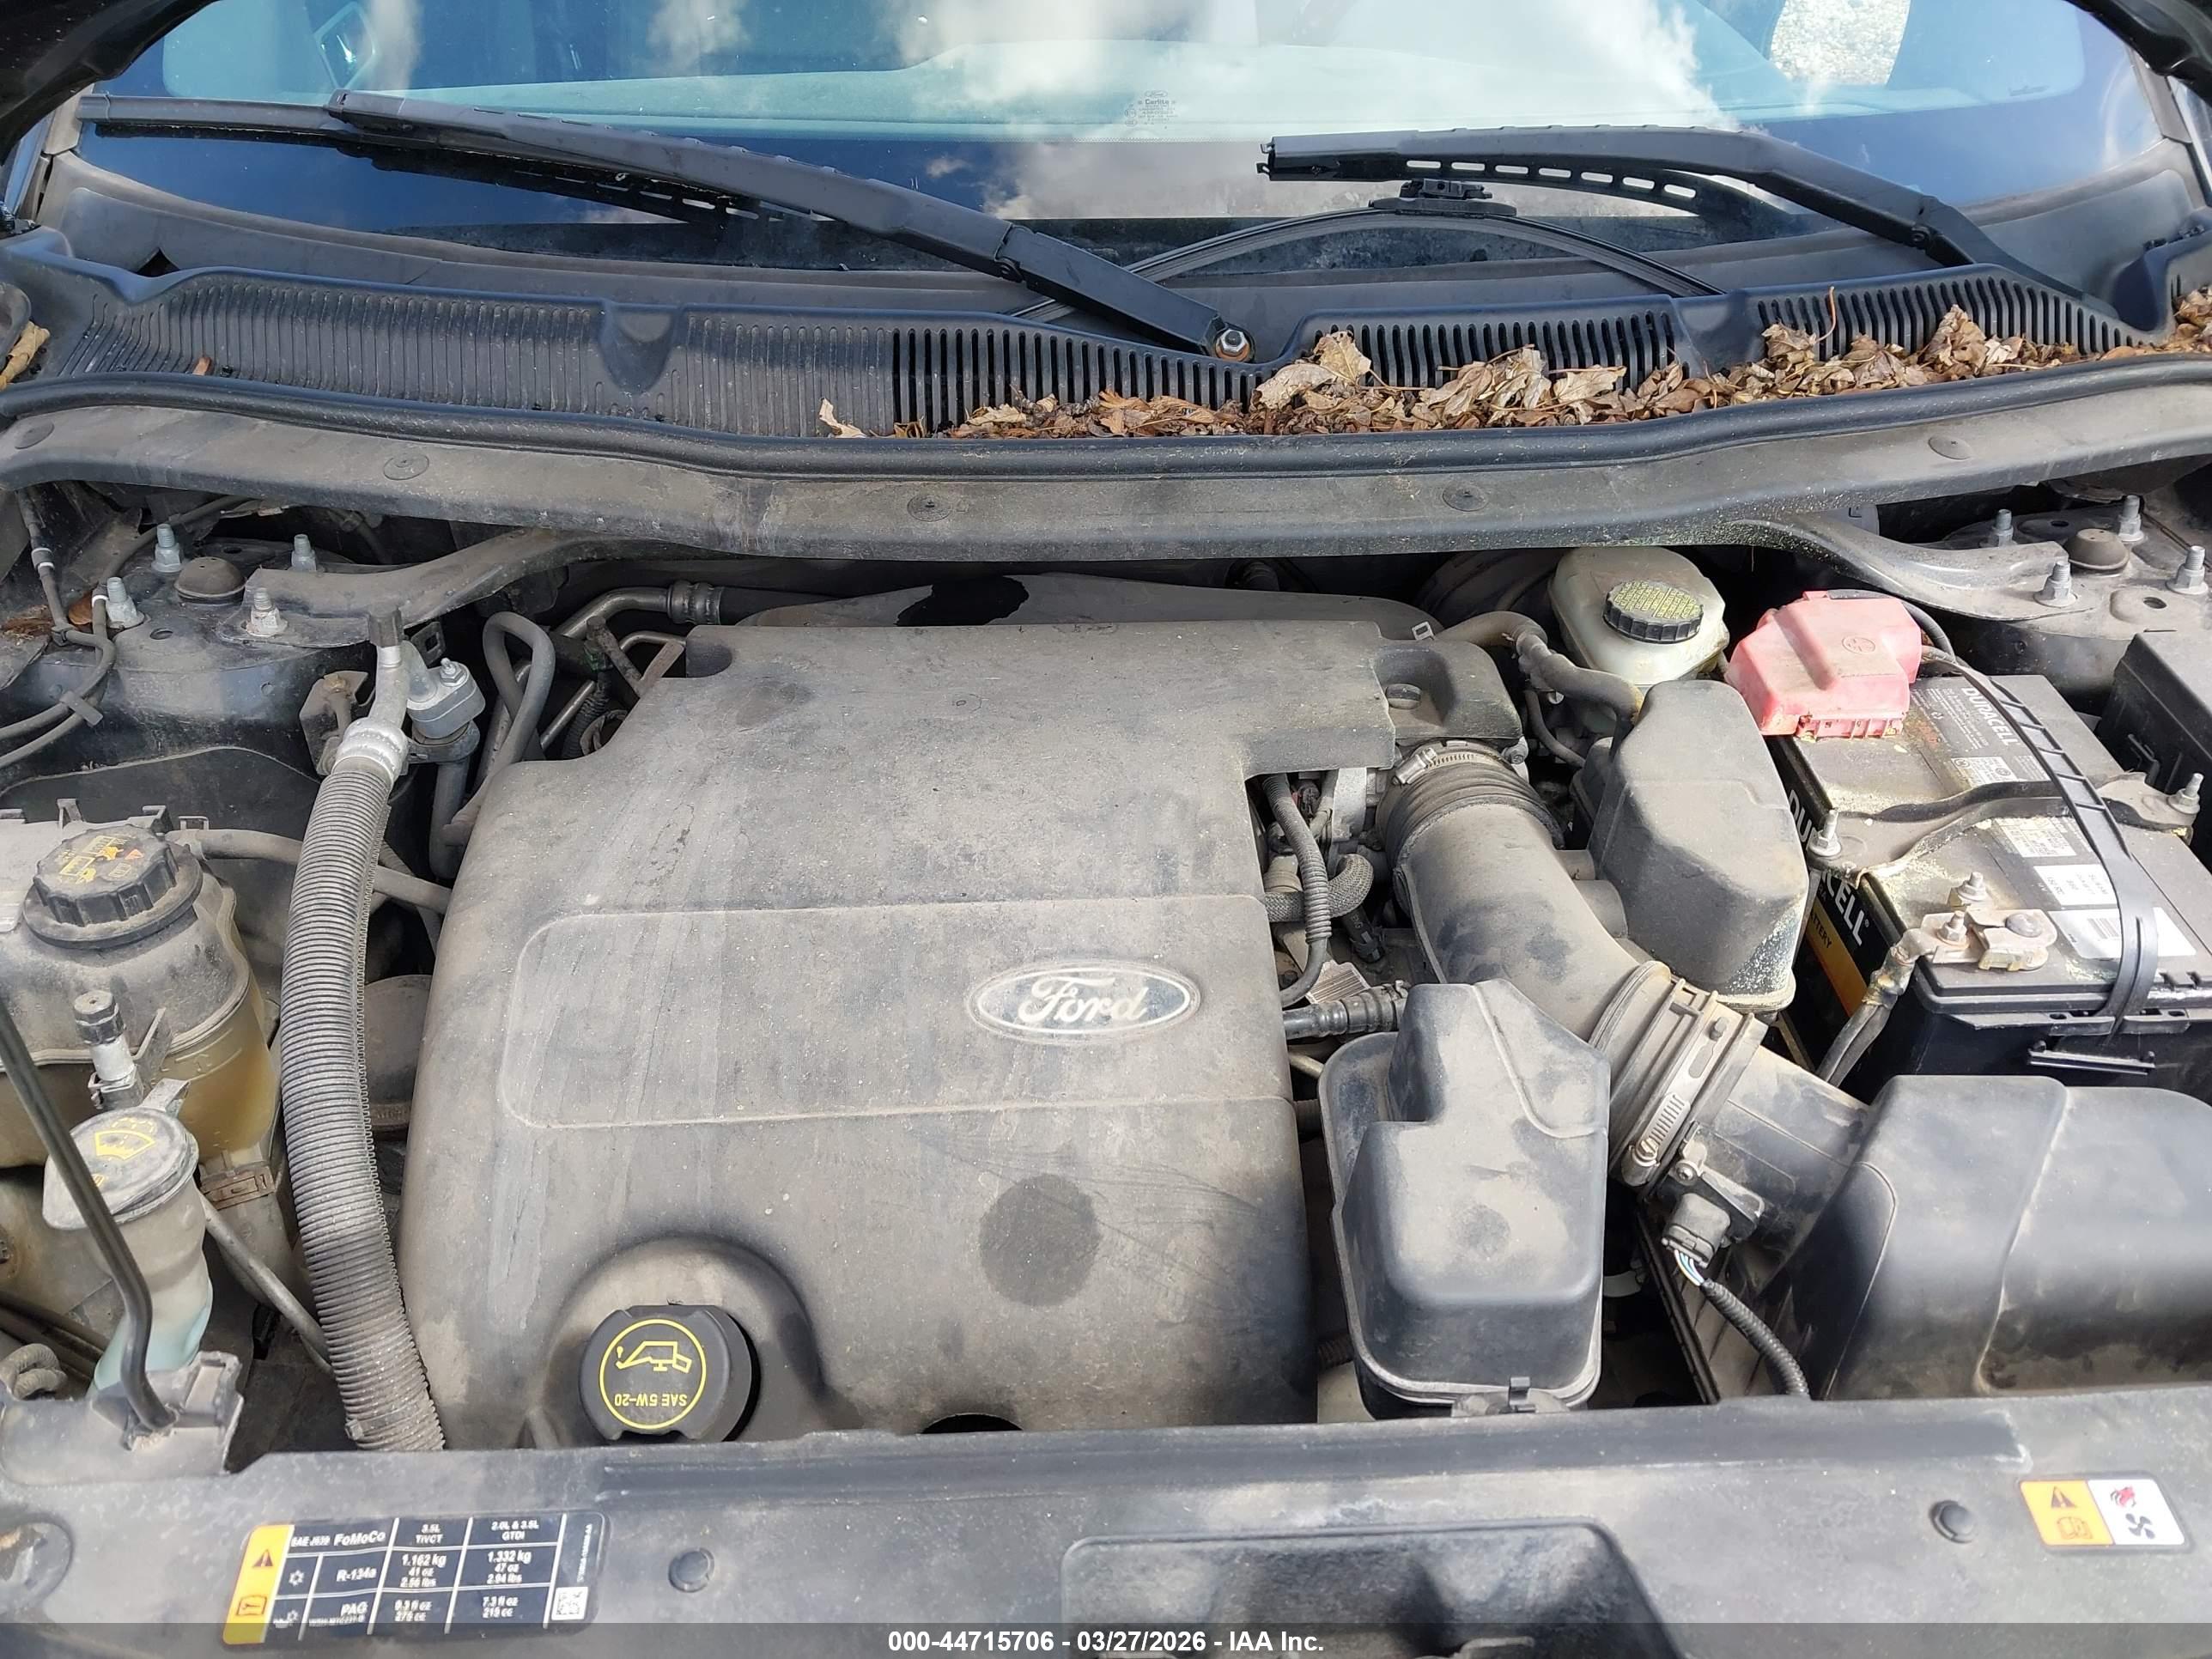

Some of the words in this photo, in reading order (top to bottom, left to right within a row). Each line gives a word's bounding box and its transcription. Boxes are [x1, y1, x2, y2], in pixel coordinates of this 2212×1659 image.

[1961, 687, 2019, 746] DURACELL
[1018, 975, 1150, 1024] Ford
[614, 1394, 658, 1407] 5W-20
[660, 1394, 688, 1407] SAE
[333, 1530, 386, 1547] FoMoCo
[431, 1553, 447, 1568] kg
[517, 1549, 532, 1565] kg
[336, 1566, 378, 1582] R-134a
[340, 1601, 368, 1616] PAG
